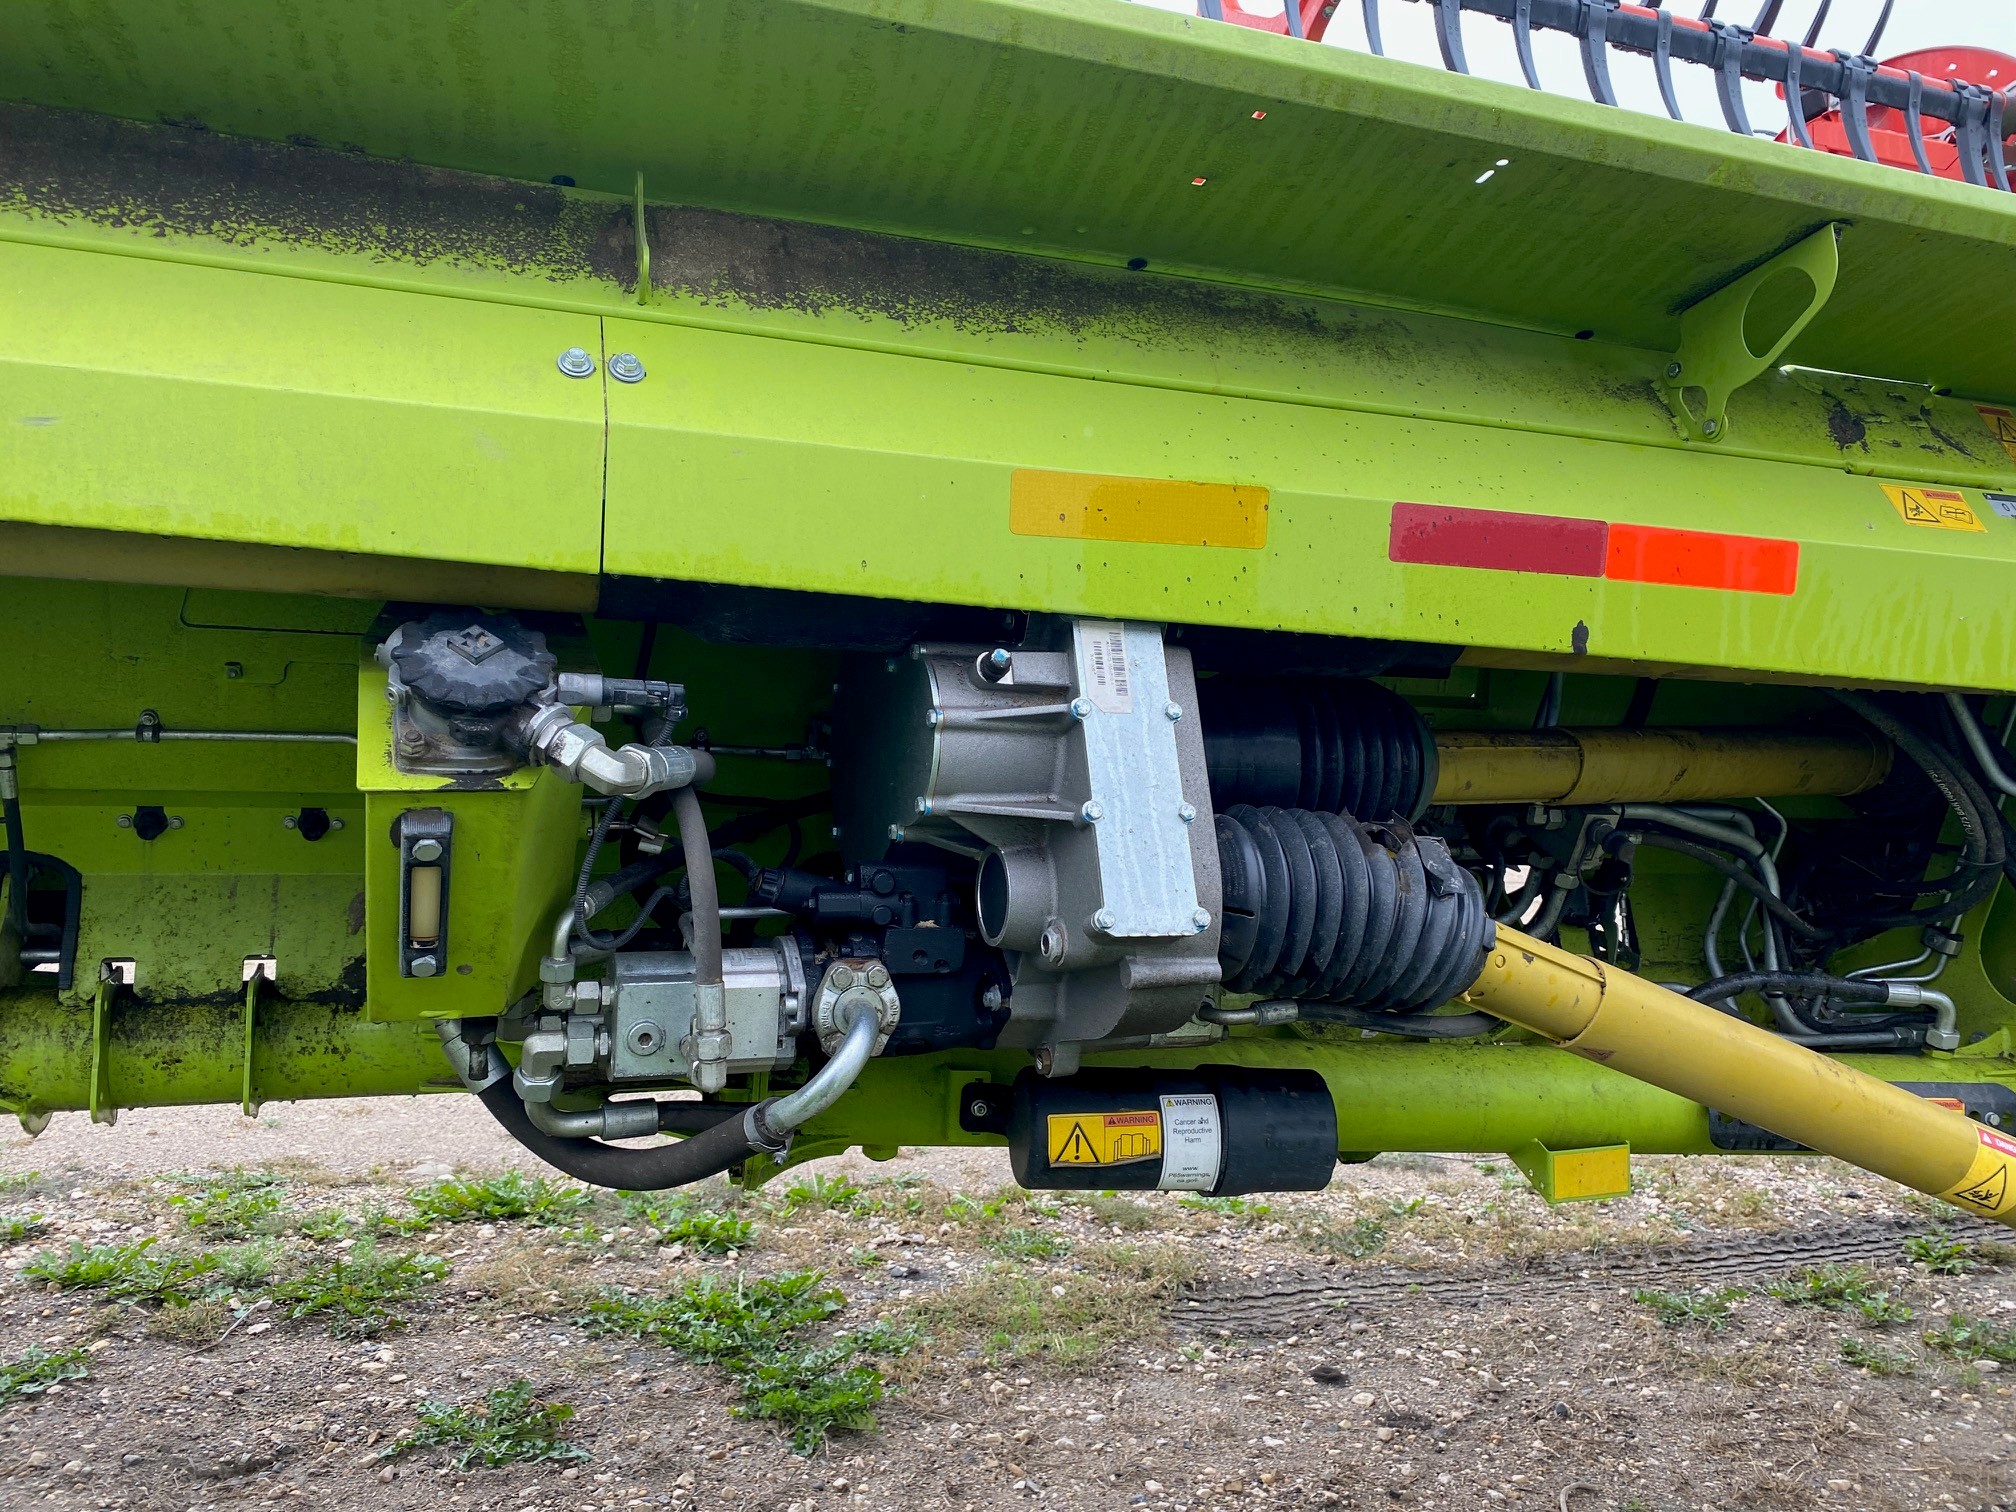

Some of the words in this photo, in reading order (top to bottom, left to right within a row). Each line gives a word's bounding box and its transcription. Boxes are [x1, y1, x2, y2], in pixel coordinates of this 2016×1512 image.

[1174, 1098, 1212, 1106] WARNING
[1117, 1115, 1154, 1124] WARNING
[1197, 1117, 1209, 1125] and
[1173, 1127, 1212, 1135] Reproductive
